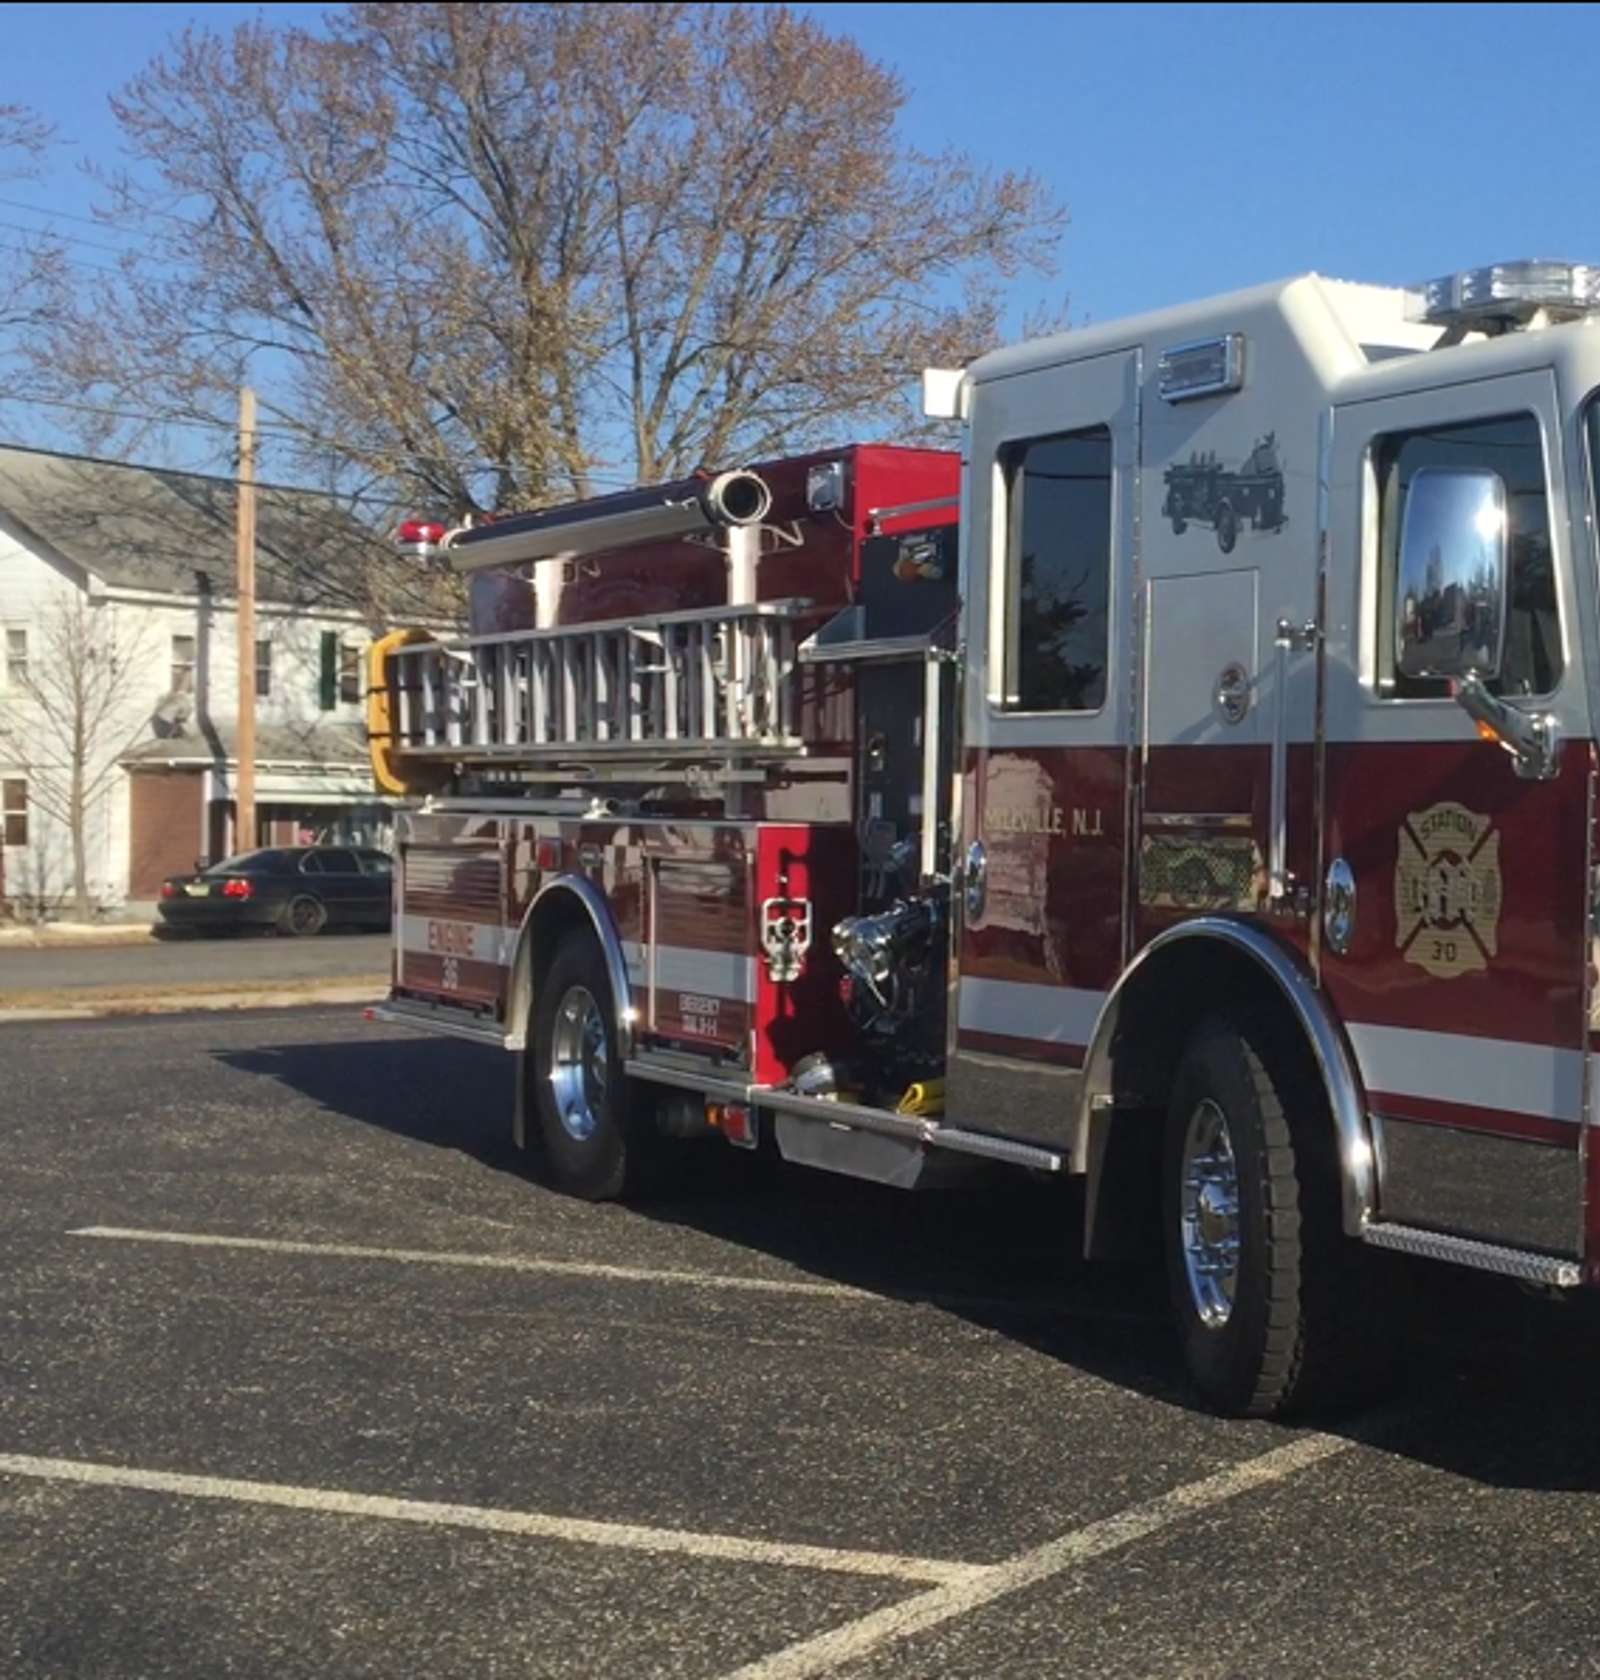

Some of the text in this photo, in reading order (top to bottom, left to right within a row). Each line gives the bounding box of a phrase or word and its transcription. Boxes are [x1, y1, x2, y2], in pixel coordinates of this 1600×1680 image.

[1420, 810, 1476, 841] STATION
[428, 919, 475, 957] ENGINE
[1431, 940, 1459, 962] 30
[442, 956, 459, 990] 36
